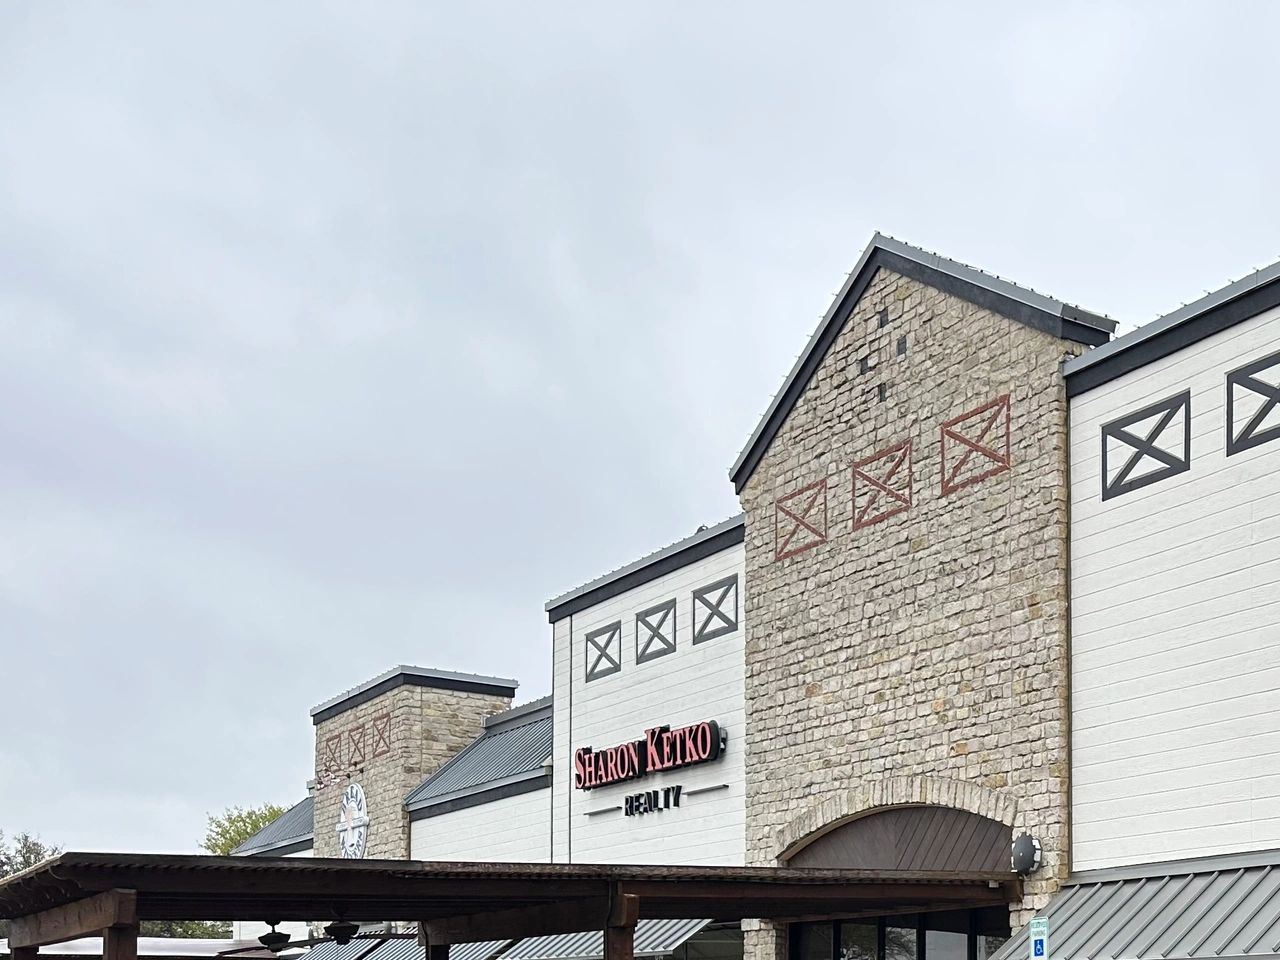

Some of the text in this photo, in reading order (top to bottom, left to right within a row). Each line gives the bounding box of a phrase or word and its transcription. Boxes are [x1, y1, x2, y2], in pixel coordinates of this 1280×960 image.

[575, 721, 715, 790] SHARON KETKO
[624, 785, 682, 816] REALTY
